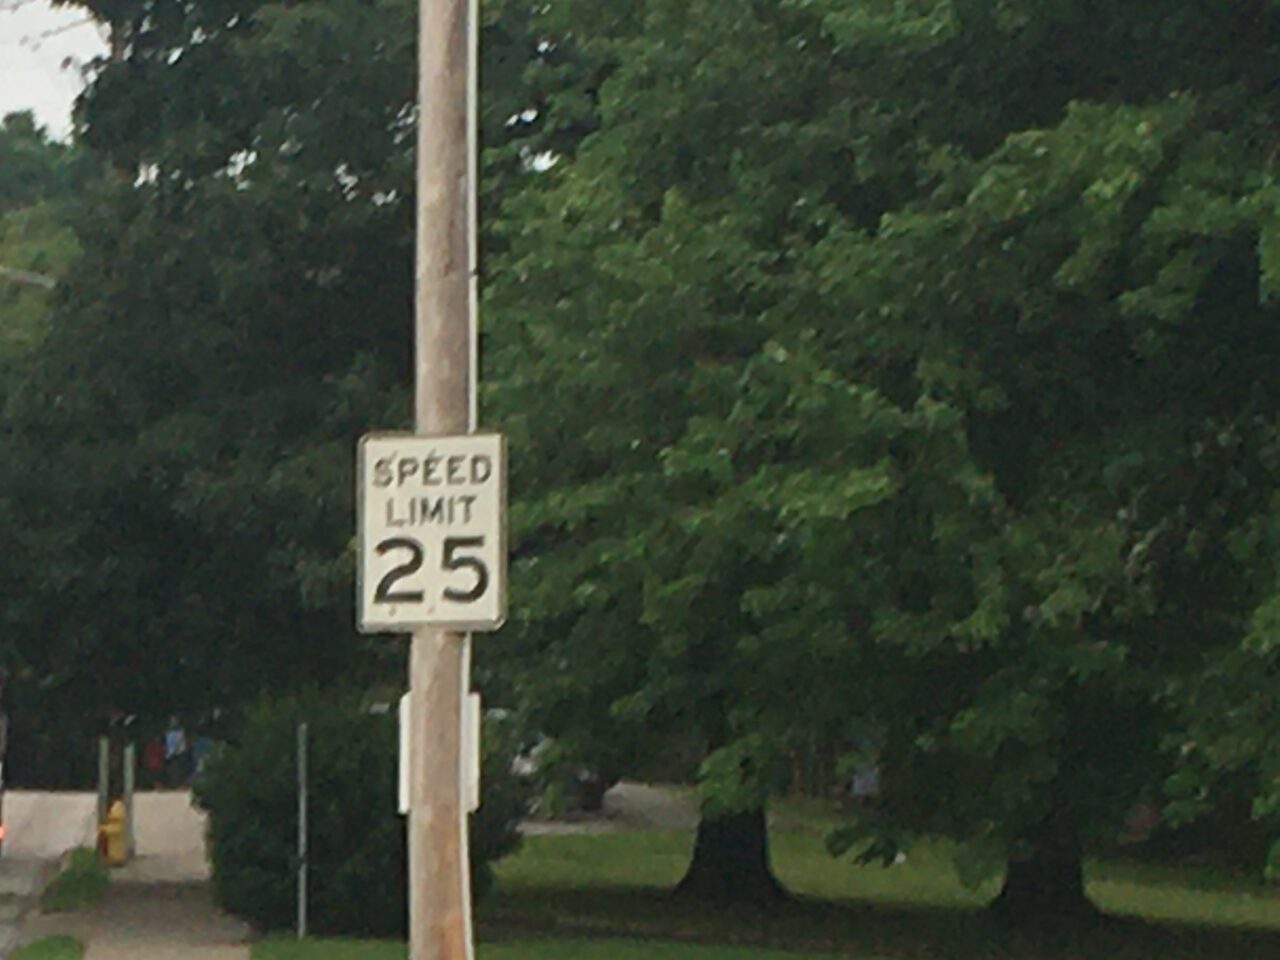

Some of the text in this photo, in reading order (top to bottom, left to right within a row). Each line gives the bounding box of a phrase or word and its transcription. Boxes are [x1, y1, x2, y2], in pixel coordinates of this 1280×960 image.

[373, 453, 493, 487] SPEED
[385, 495, 478, 527] LIMIT
[373, 536, 490, 604] 25
